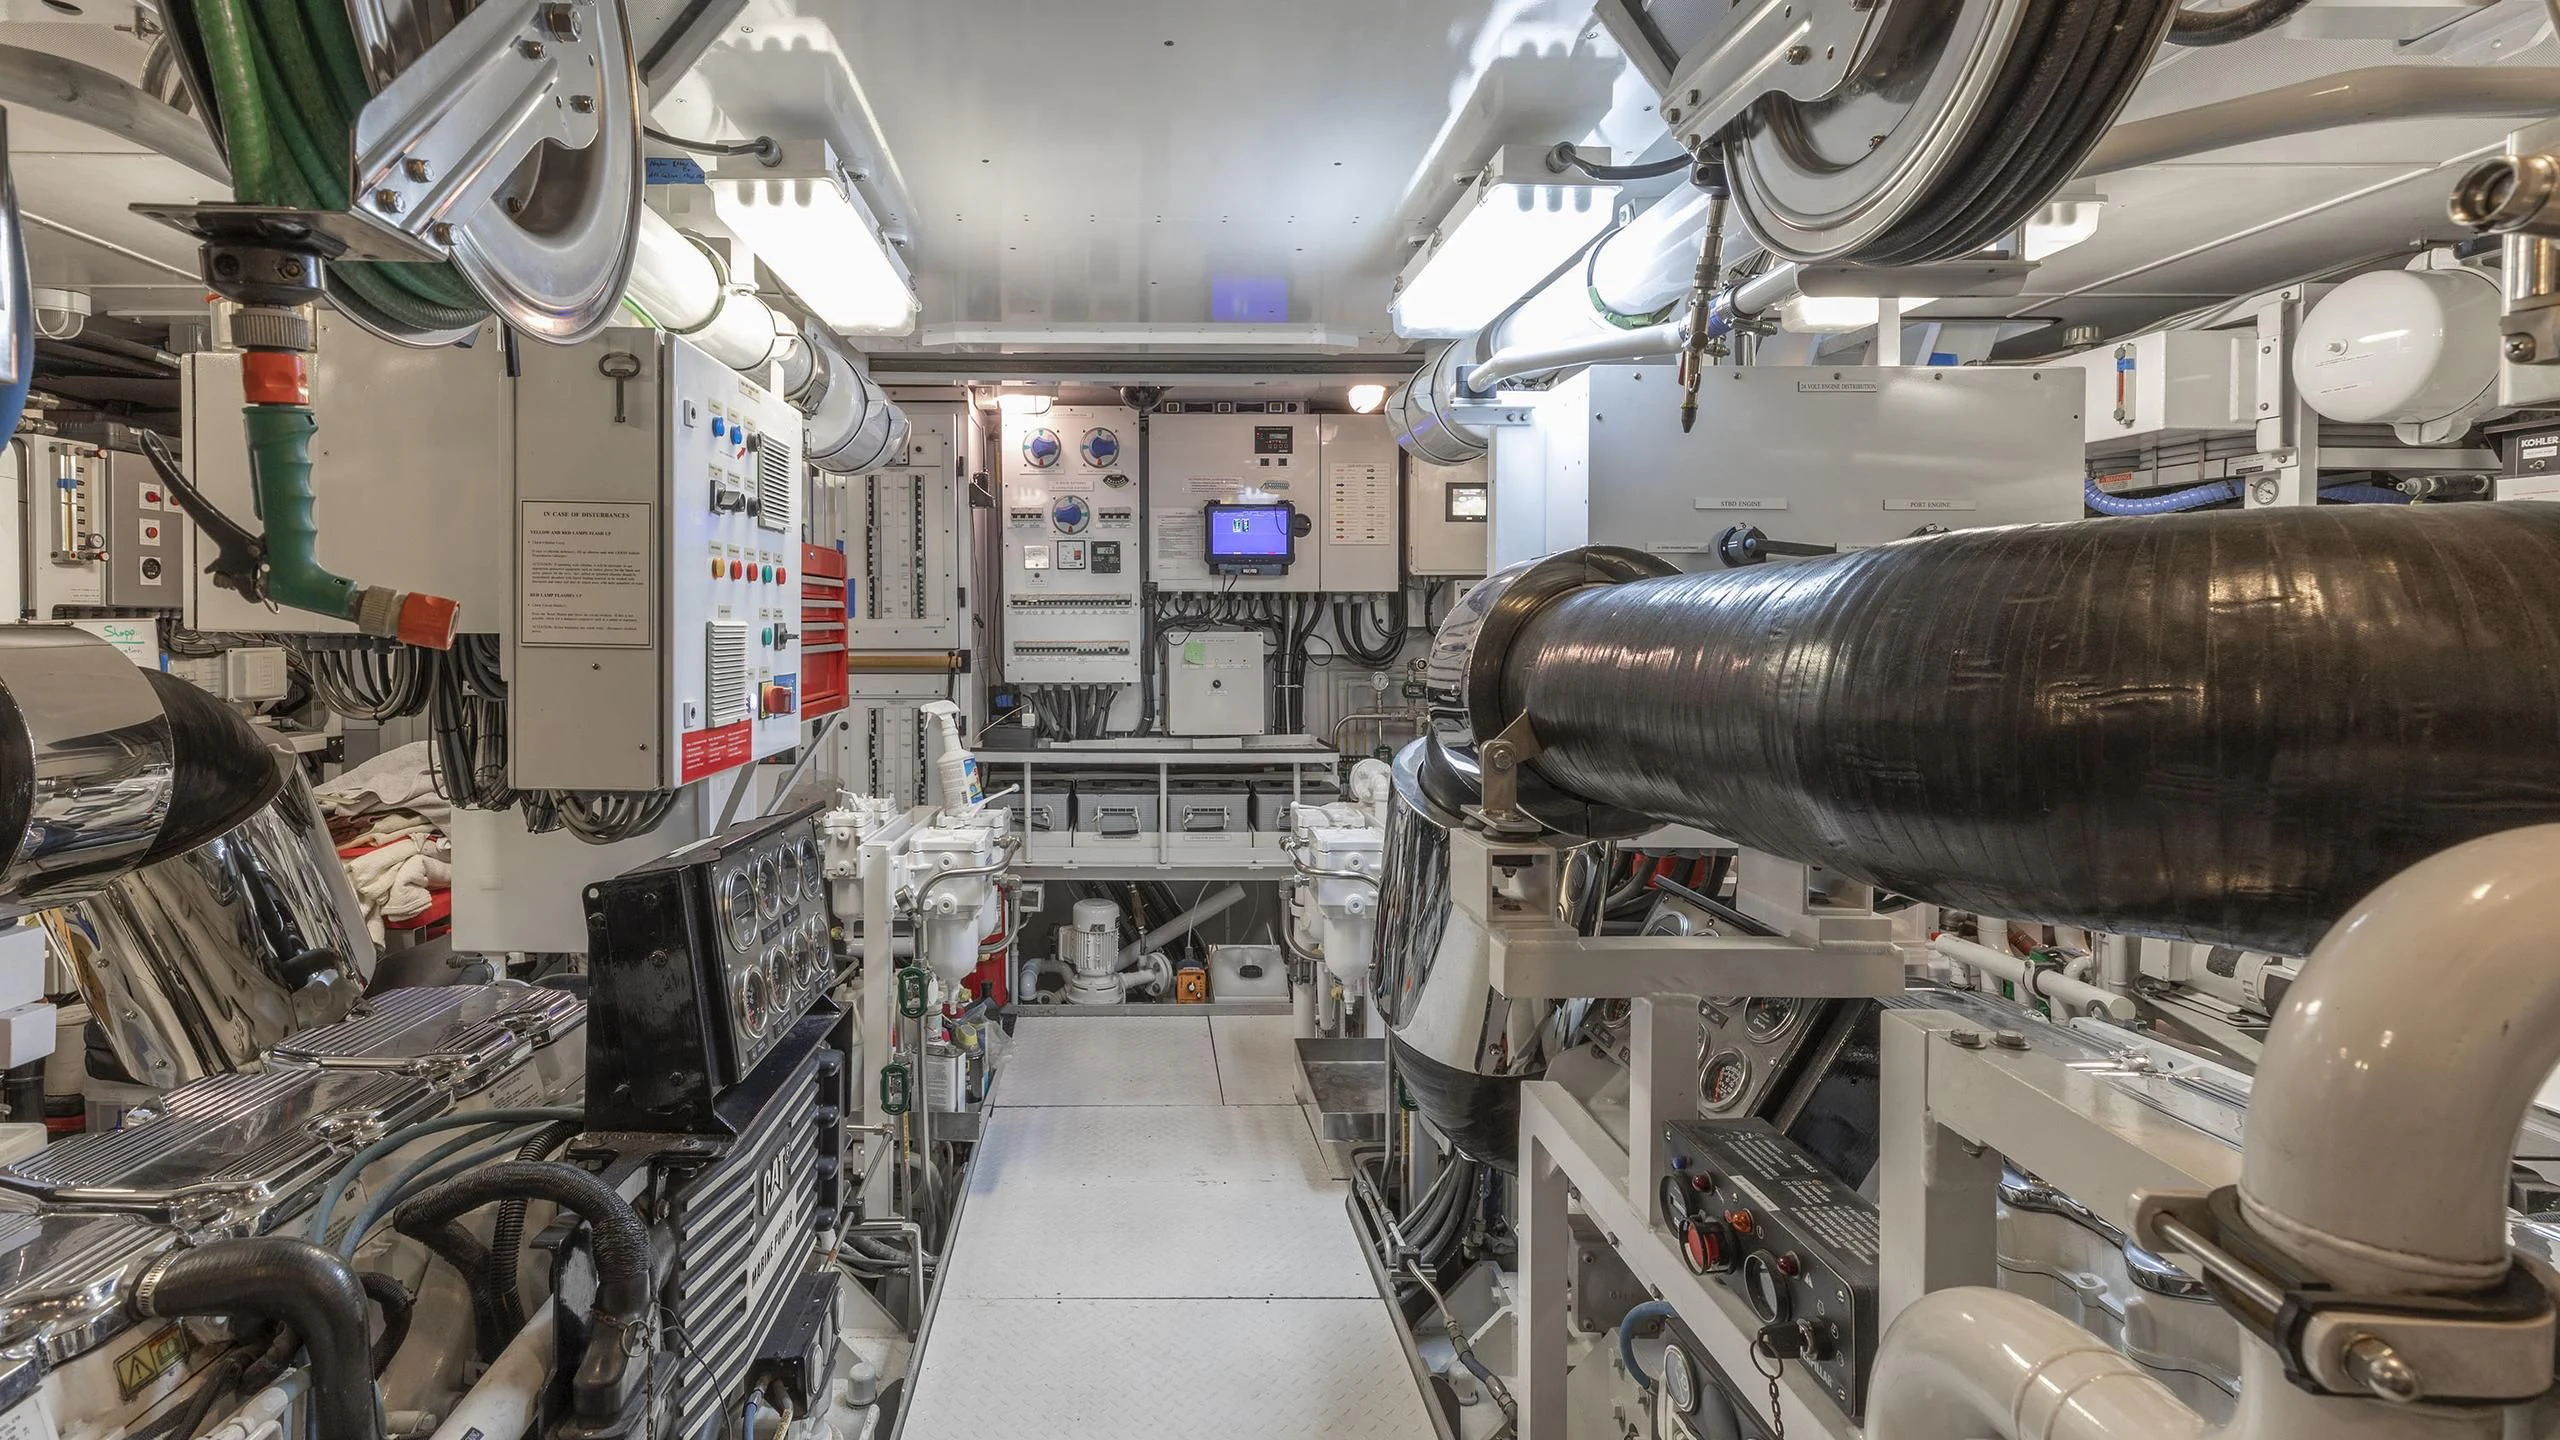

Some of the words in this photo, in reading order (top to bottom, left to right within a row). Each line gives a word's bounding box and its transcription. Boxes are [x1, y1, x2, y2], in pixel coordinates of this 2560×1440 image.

[2520, 435, 2559, 448] KOHLER
[752, 1240, 774, 1290] MARINE
[774, 1209, 793, 1252] POWER
